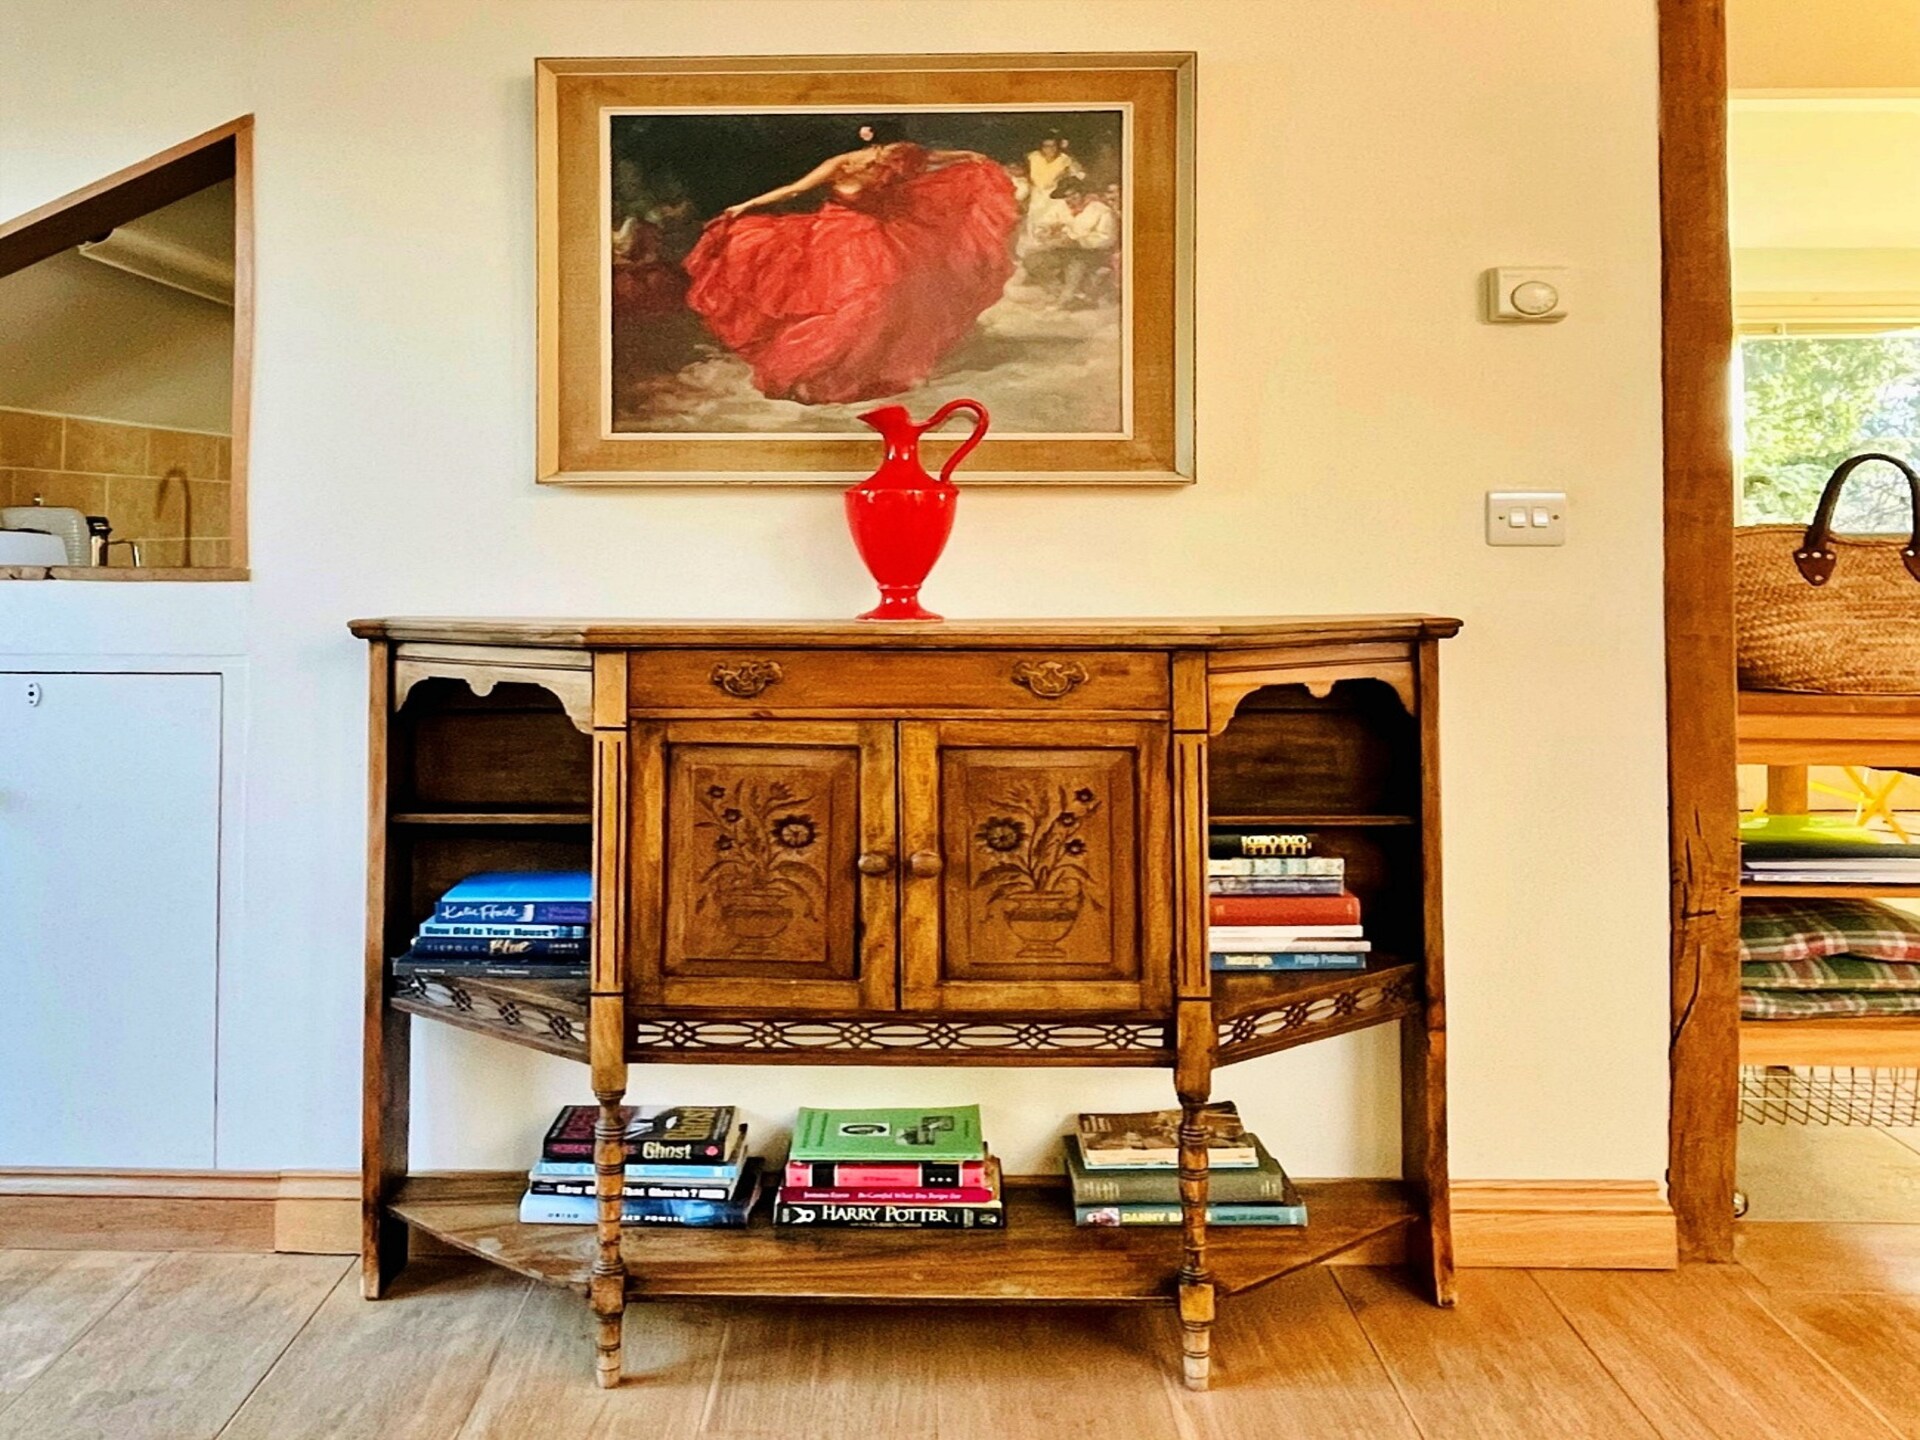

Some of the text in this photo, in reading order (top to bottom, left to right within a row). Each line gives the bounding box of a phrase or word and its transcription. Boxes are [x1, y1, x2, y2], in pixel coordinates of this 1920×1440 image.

[425, 926, 449, 934] How
[453, 926, 471, 935] Old
[642, 1141, 692, 1160] Ghost
[822, 1205, 881, 1221] HARRY
[885, 1206, 951, 1223] POTTER
[1121, 1212, 1166, 1222] DANNY
